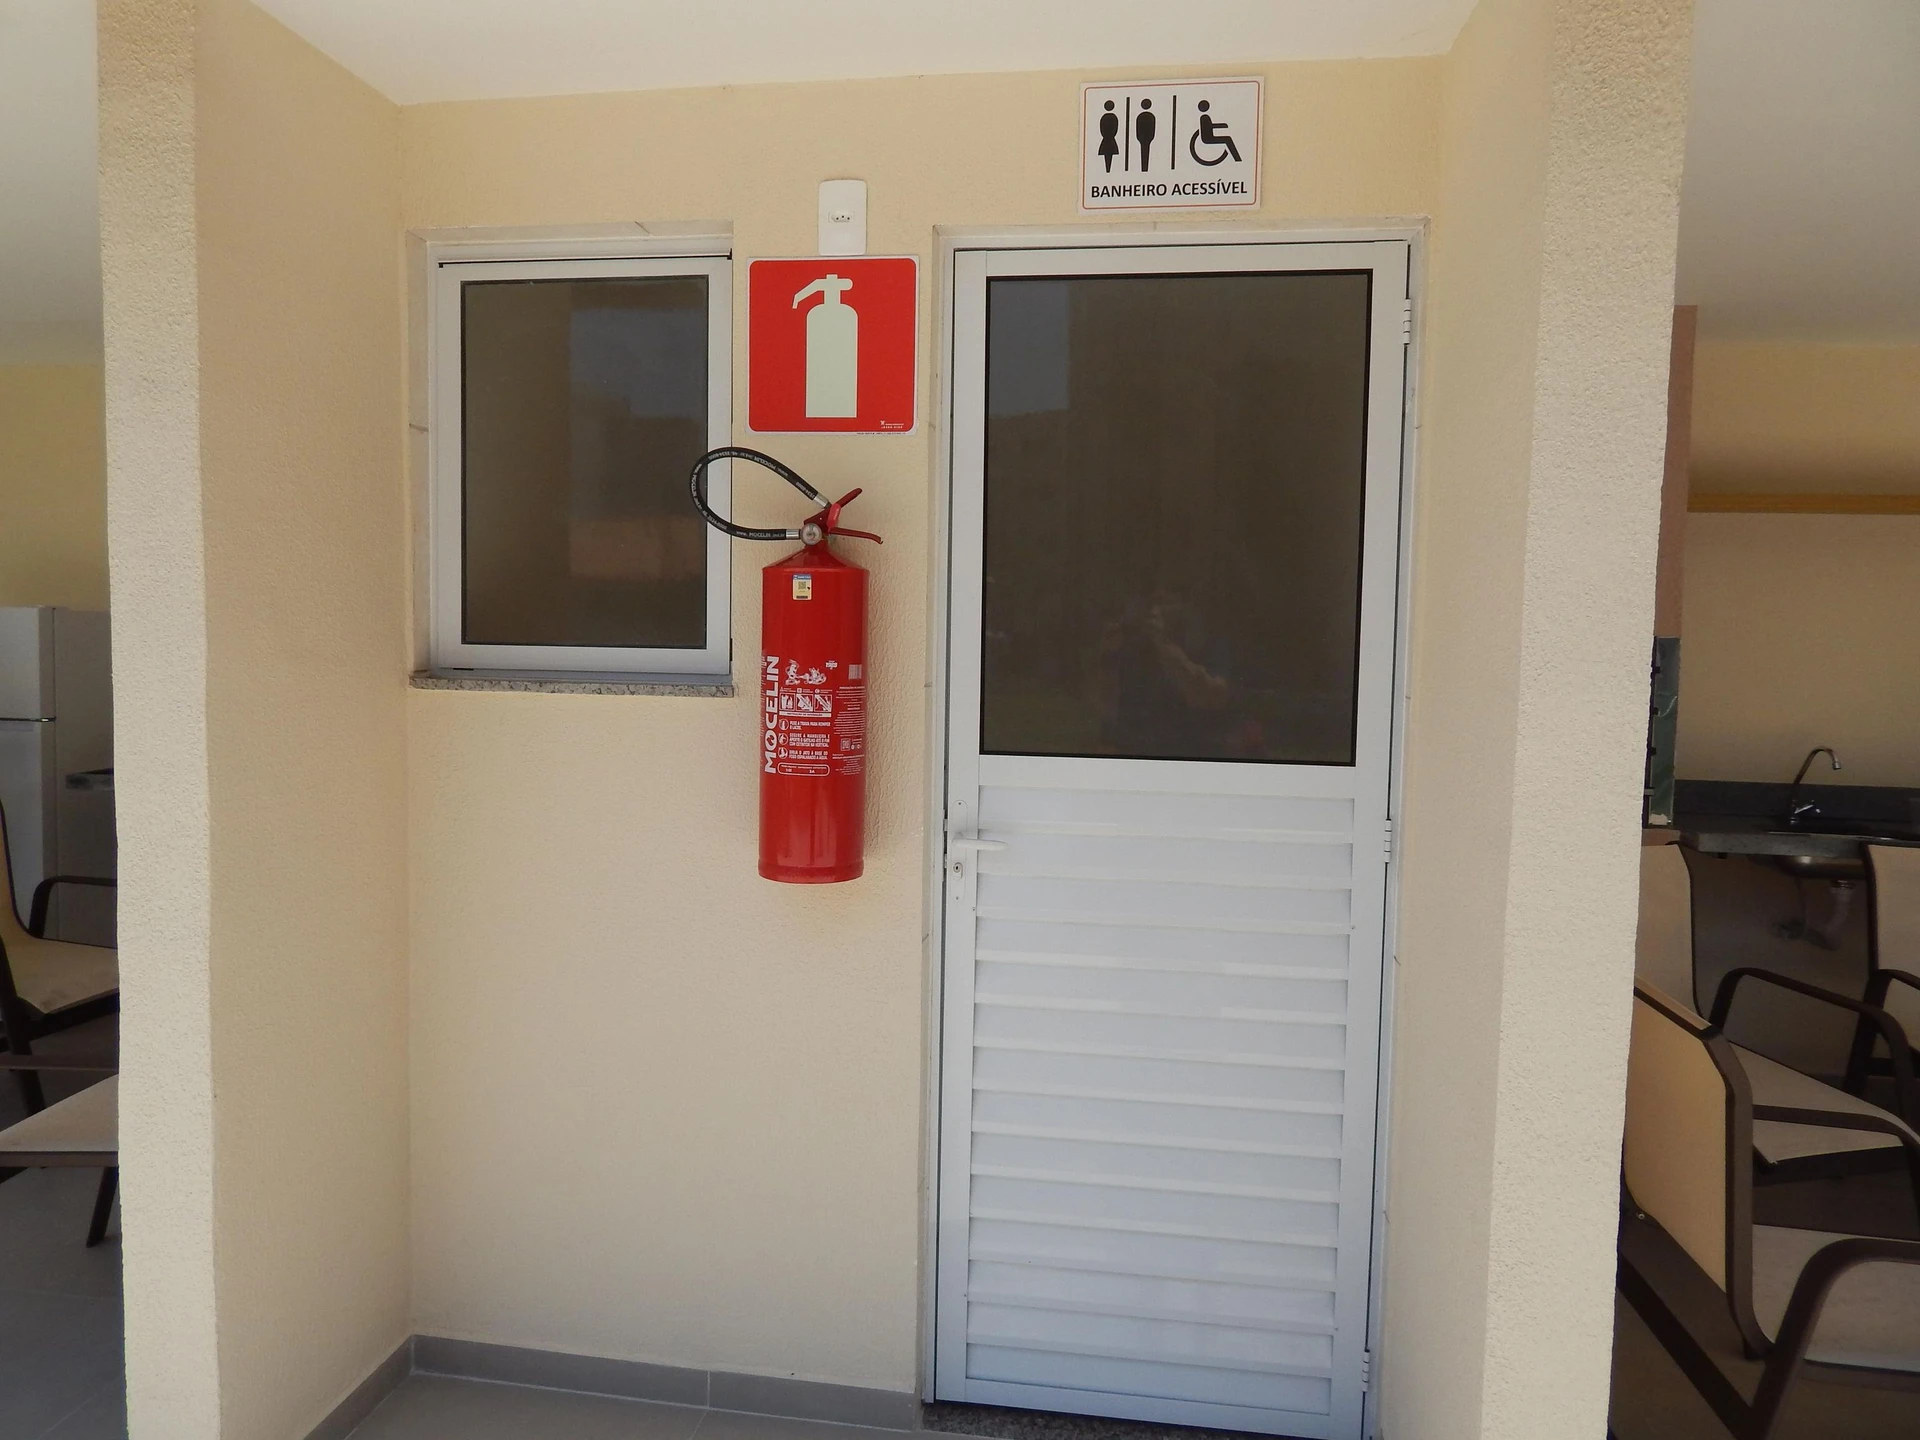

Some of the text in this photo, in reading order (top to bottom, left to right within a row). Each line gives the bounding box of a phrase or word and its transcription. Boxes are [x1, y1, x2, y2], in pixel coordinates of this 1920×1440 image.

[1091, 179, 1247, 198] BANHEIRO ACESSÍVEL
[764, 655, 780, 774] MOCELIN
